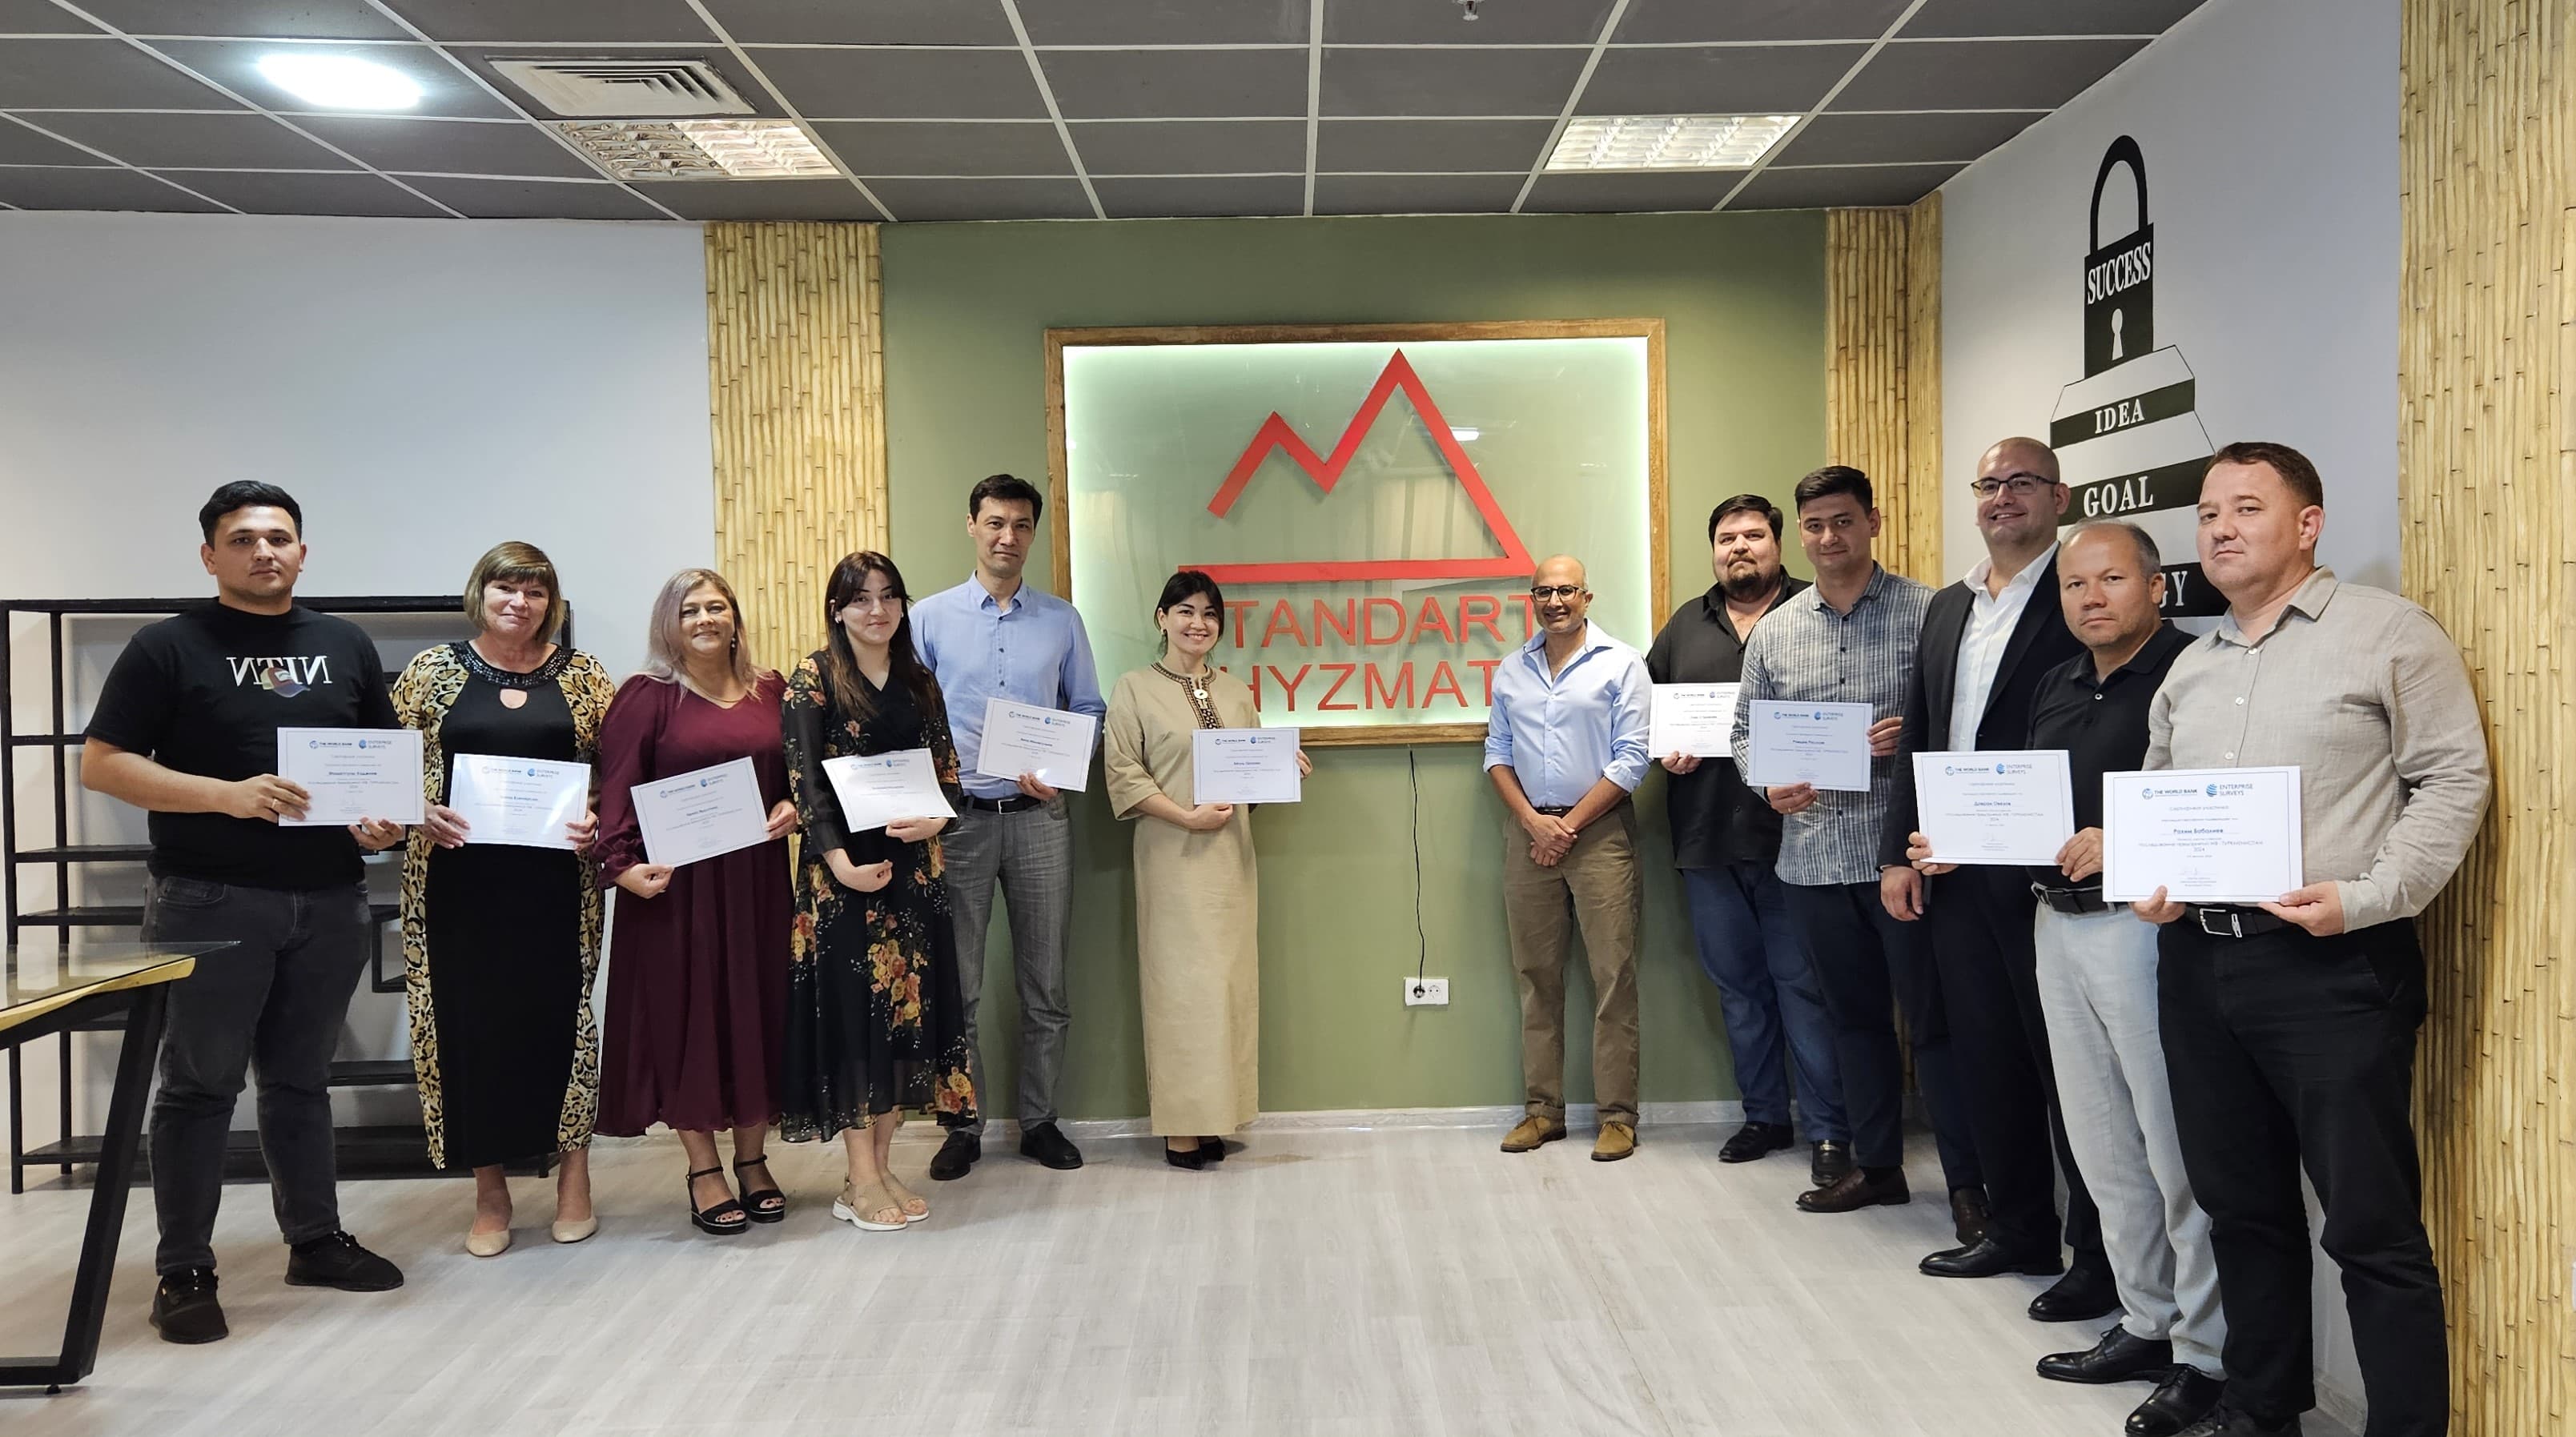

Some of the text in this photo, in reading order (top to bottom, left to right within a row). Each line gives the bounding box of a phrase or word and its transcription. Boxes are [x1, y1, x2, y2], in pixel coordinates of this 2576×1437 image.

[2088, 241, 2151, 305] SUCCESS
[2095, 399, 2145, 434] IDEA
[2084, 476, 2153, 517] GOAL
[1224, 595, 1533, 648] TANDART
